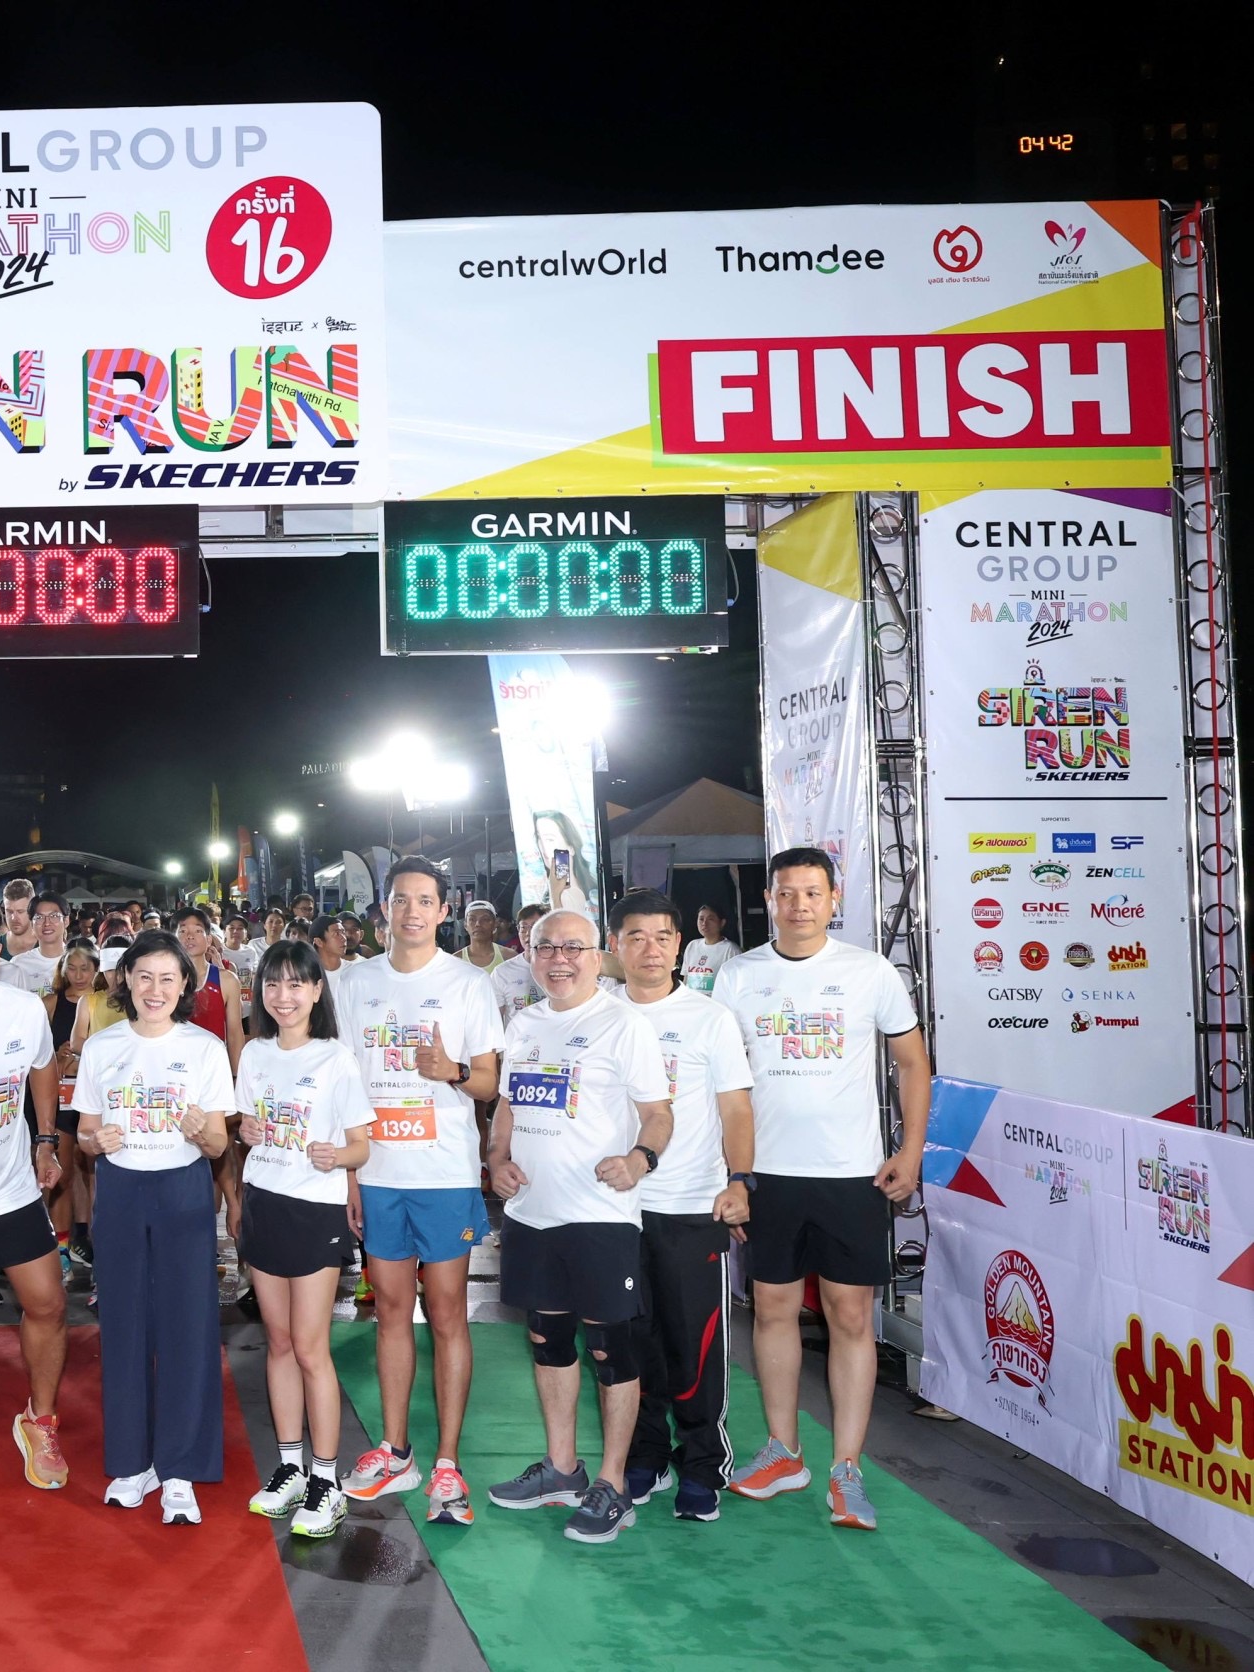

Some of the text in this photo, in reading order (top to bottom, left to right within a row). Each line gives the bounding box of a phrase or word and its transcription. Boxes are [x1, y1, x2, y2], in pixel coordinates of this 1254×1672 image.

[236, 184, 295, 216] ครั้งที่
[233, 218, 305, 287] 16
[458, 247, 667, 278] centralwOrld
[715, 244, 885, 274] Thamdee
[82, 343, 360, 455] RUN
[691, 341, 1132, 443] FINISH
[59, 460, 359, 492] by SKECHERS
[471, 511, 631, 537] GARMIN
[955, 521, 1137, 547] CENTRAL
[977, 555, 1117, 582] GROUP
[1031, 590, 1065, 600] MINI
[970, 602, 1128, 622] MARATHON
[1028, 621, 1071, 641] 2024
[779, 676, 847, 720] CENTRAL
[977, 687, 1129, 726] SIREN
[787, 712, 841, 749] GROUP
[1024, 729, 1130, 769] RUN
[1035, 772, 1130, 781] SKECHERS
[1110, 836, 1144, 849] SF
[1022, 902, 1070, 912] GNC
[1091, 903, 1145, 919] Mineré
[1111, 962, 1146, 970] STATION
[988, 988, 1043, 1003] GATSBY
[1081, 990, 1136, 1000] SENKA
[756, 1012, 844, 1037] SIREN
[1095, 1016, 1139, 1028] Pumpui
[782, 1036, 844, 1060] RUN
[107, 1086, 187, 1110] SIREN
[516, 1085, 558, 1104] 0894
[129, 1109, 183, 1133] RUN
[381, 1120, 426, 1138] 1396
[1049, 1160, 1066, 1171] MINI
[1025, 1164, 1091, 1197] MARATHON
[1050, 1185, 1068, 1201] 2024
[1138, 1157, 1209, 1206] SIREN
[1158, 1196, 1210, 1243] RUN
[1163, 1233, 1210, 1253] SKECHERS
[987, 1254, 1053, 1345] GOLDEN MOUNTAIN
[998, 1396, 1036, 1427] SINCE 1954
[1128, 1434, 1251, 1506] STATION
